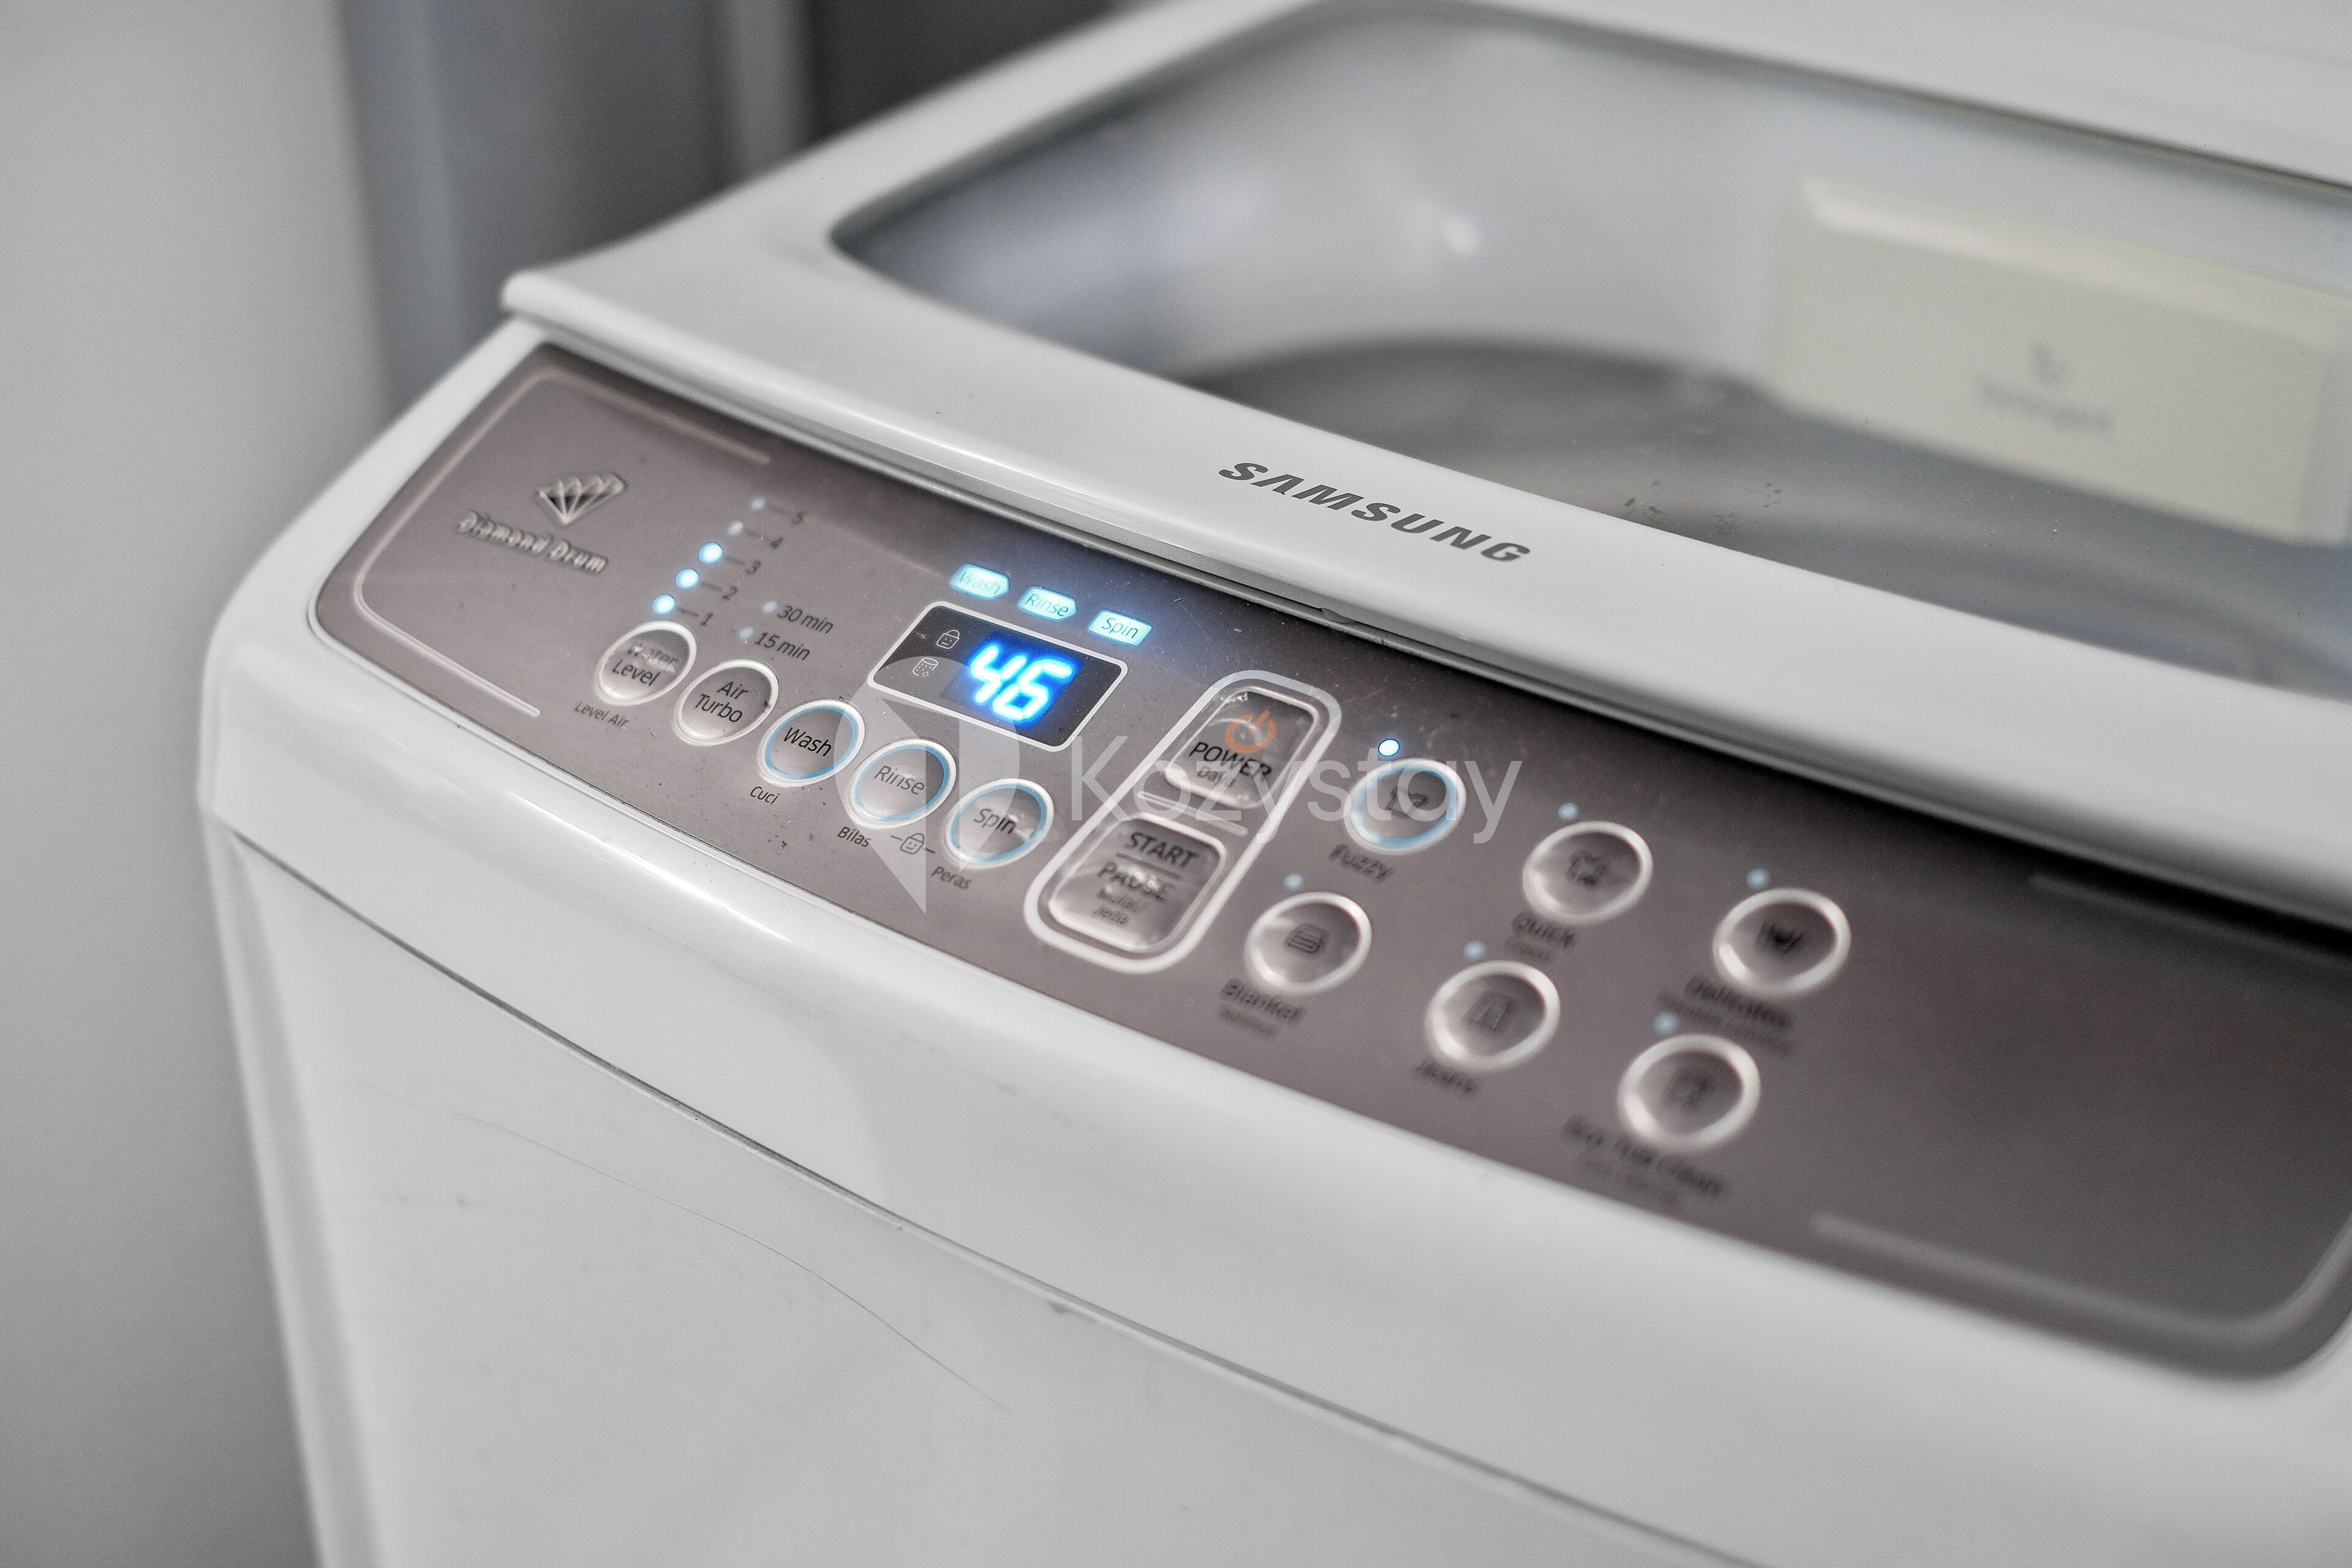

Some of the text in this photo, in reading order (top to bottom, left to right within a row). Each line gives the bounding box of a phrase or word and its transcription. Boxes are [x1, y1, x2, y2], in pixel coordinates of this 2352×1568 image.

[1218, 462, 1531, 562] SAMSUNG
[458, 510, 608, 574] Diamond Drum
[745, 559, 761, 575] 3
[721, 586, 739, 601] 2
[959, 570, 1001, 595] Wash
[1024, 592, 1070, 617] Rinse
[700, 612, 714, 627] 1
[776, 605, 834, 635] 30 min
[1100, 617, 1139, 639] Spin
[754, 631, 811, 661] 15 min
[611, 658, 662, 687] Level
[971, 643, 1074, 723] 46
[716, 680, 749, 700] Air
[573, 701, 630, 729] Level Air
[694, 693, 744, 723] Turbo
[782, 726, 834, 758] Wash
[1189, 741, 1272, 783] POWER
[873, 764, 926, 797] Rinse
[748, 785, 781, 806] Cuci
[972, 807, 1017, 837] Spin
[837, 826, 872, 849] Bilas
[1125, 832, 1200, 869] START
[931, 864, 972, 891] Peras
